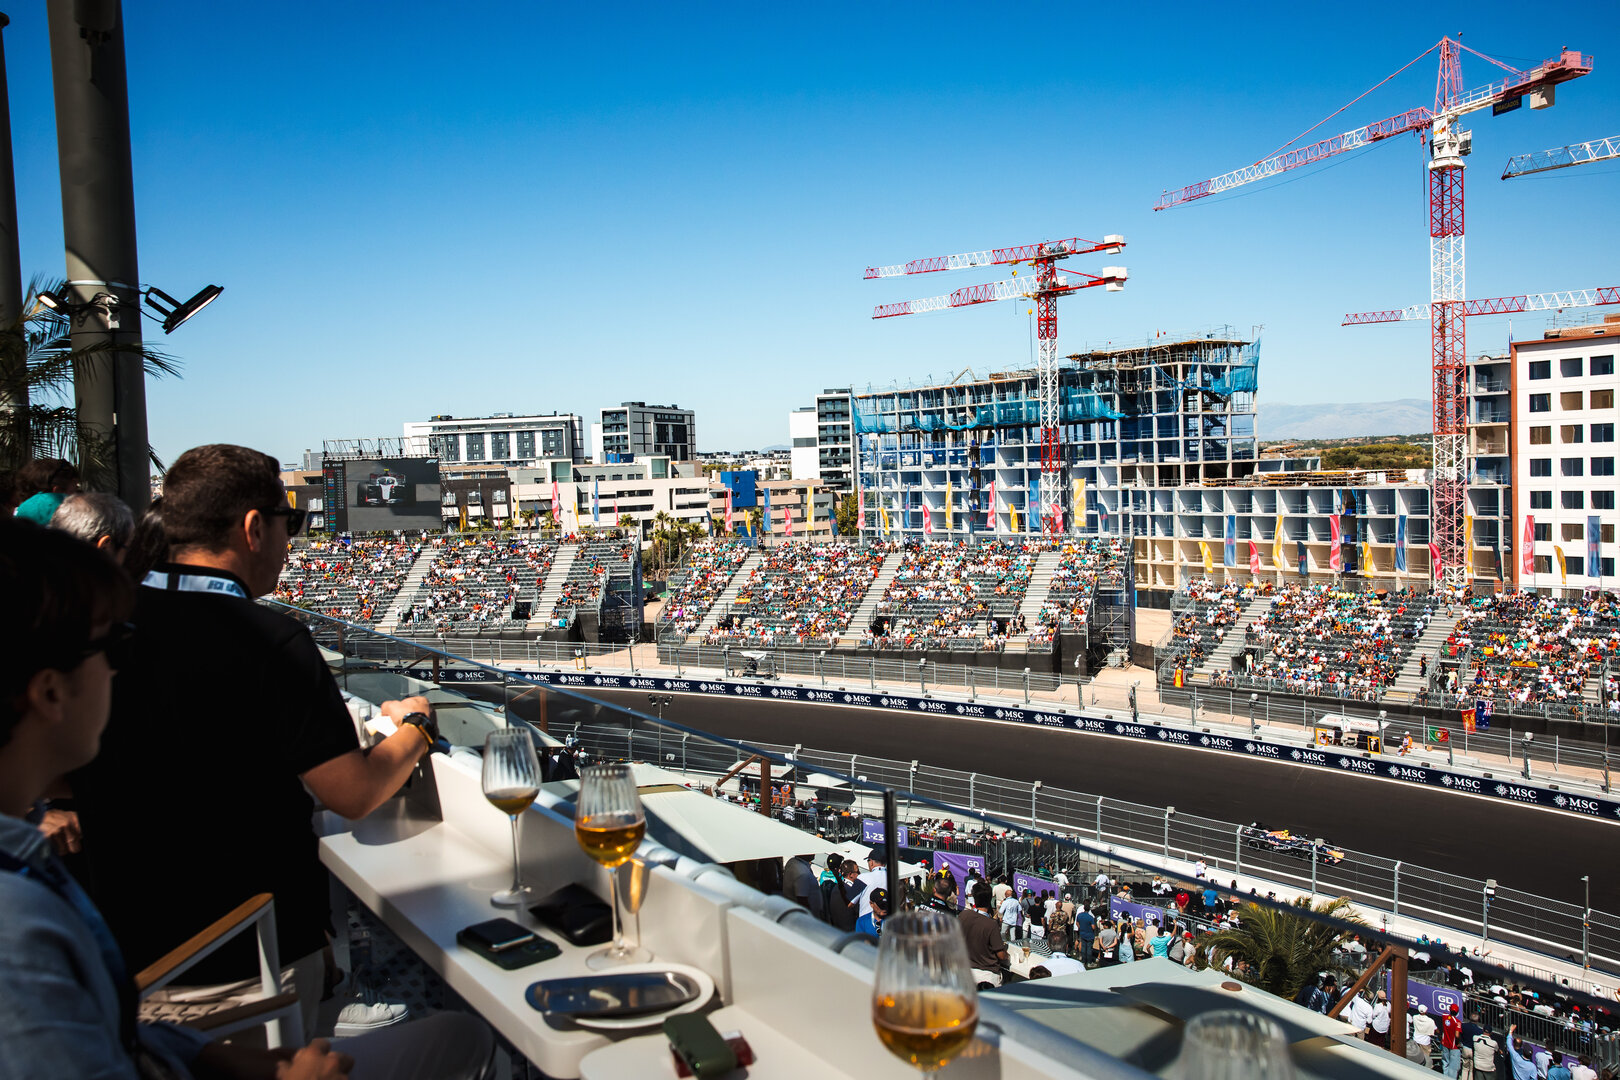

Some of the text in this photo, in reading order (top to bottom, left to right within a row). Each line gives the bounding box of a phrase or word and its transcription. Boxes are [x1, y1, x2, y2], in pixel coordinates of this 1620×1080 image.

[890, 698, 908, 706] MSC
[928, 702, 946, 710] MSC
[966, 706, 984, 714] MSC
[1005, 710, 1024, 719] MSC
[1044, 715, 1063, 724] MSC
[1085, 720, 1104, 729] MSC
[1126, 725, 1146, 735] MSC
[1168, 731, 1189, 741] MSC
[1211, 737, 1232, 747] MSC
[1257, 744, 1278, 754] MSC
[1303, 751, 1325, 762] MSC
[1352, 759, 1375, 770] MSC
[1401, 768, 1425, 779] MSC
[1454, 777, 1480, 789] MSC
[1509, 786, 1536, 799] MSC
[1569, 797, 1598, 810] MSC
[1570, 806, 1598, 815] CRUISES
[1438, 995, 1454, 1005] GD
